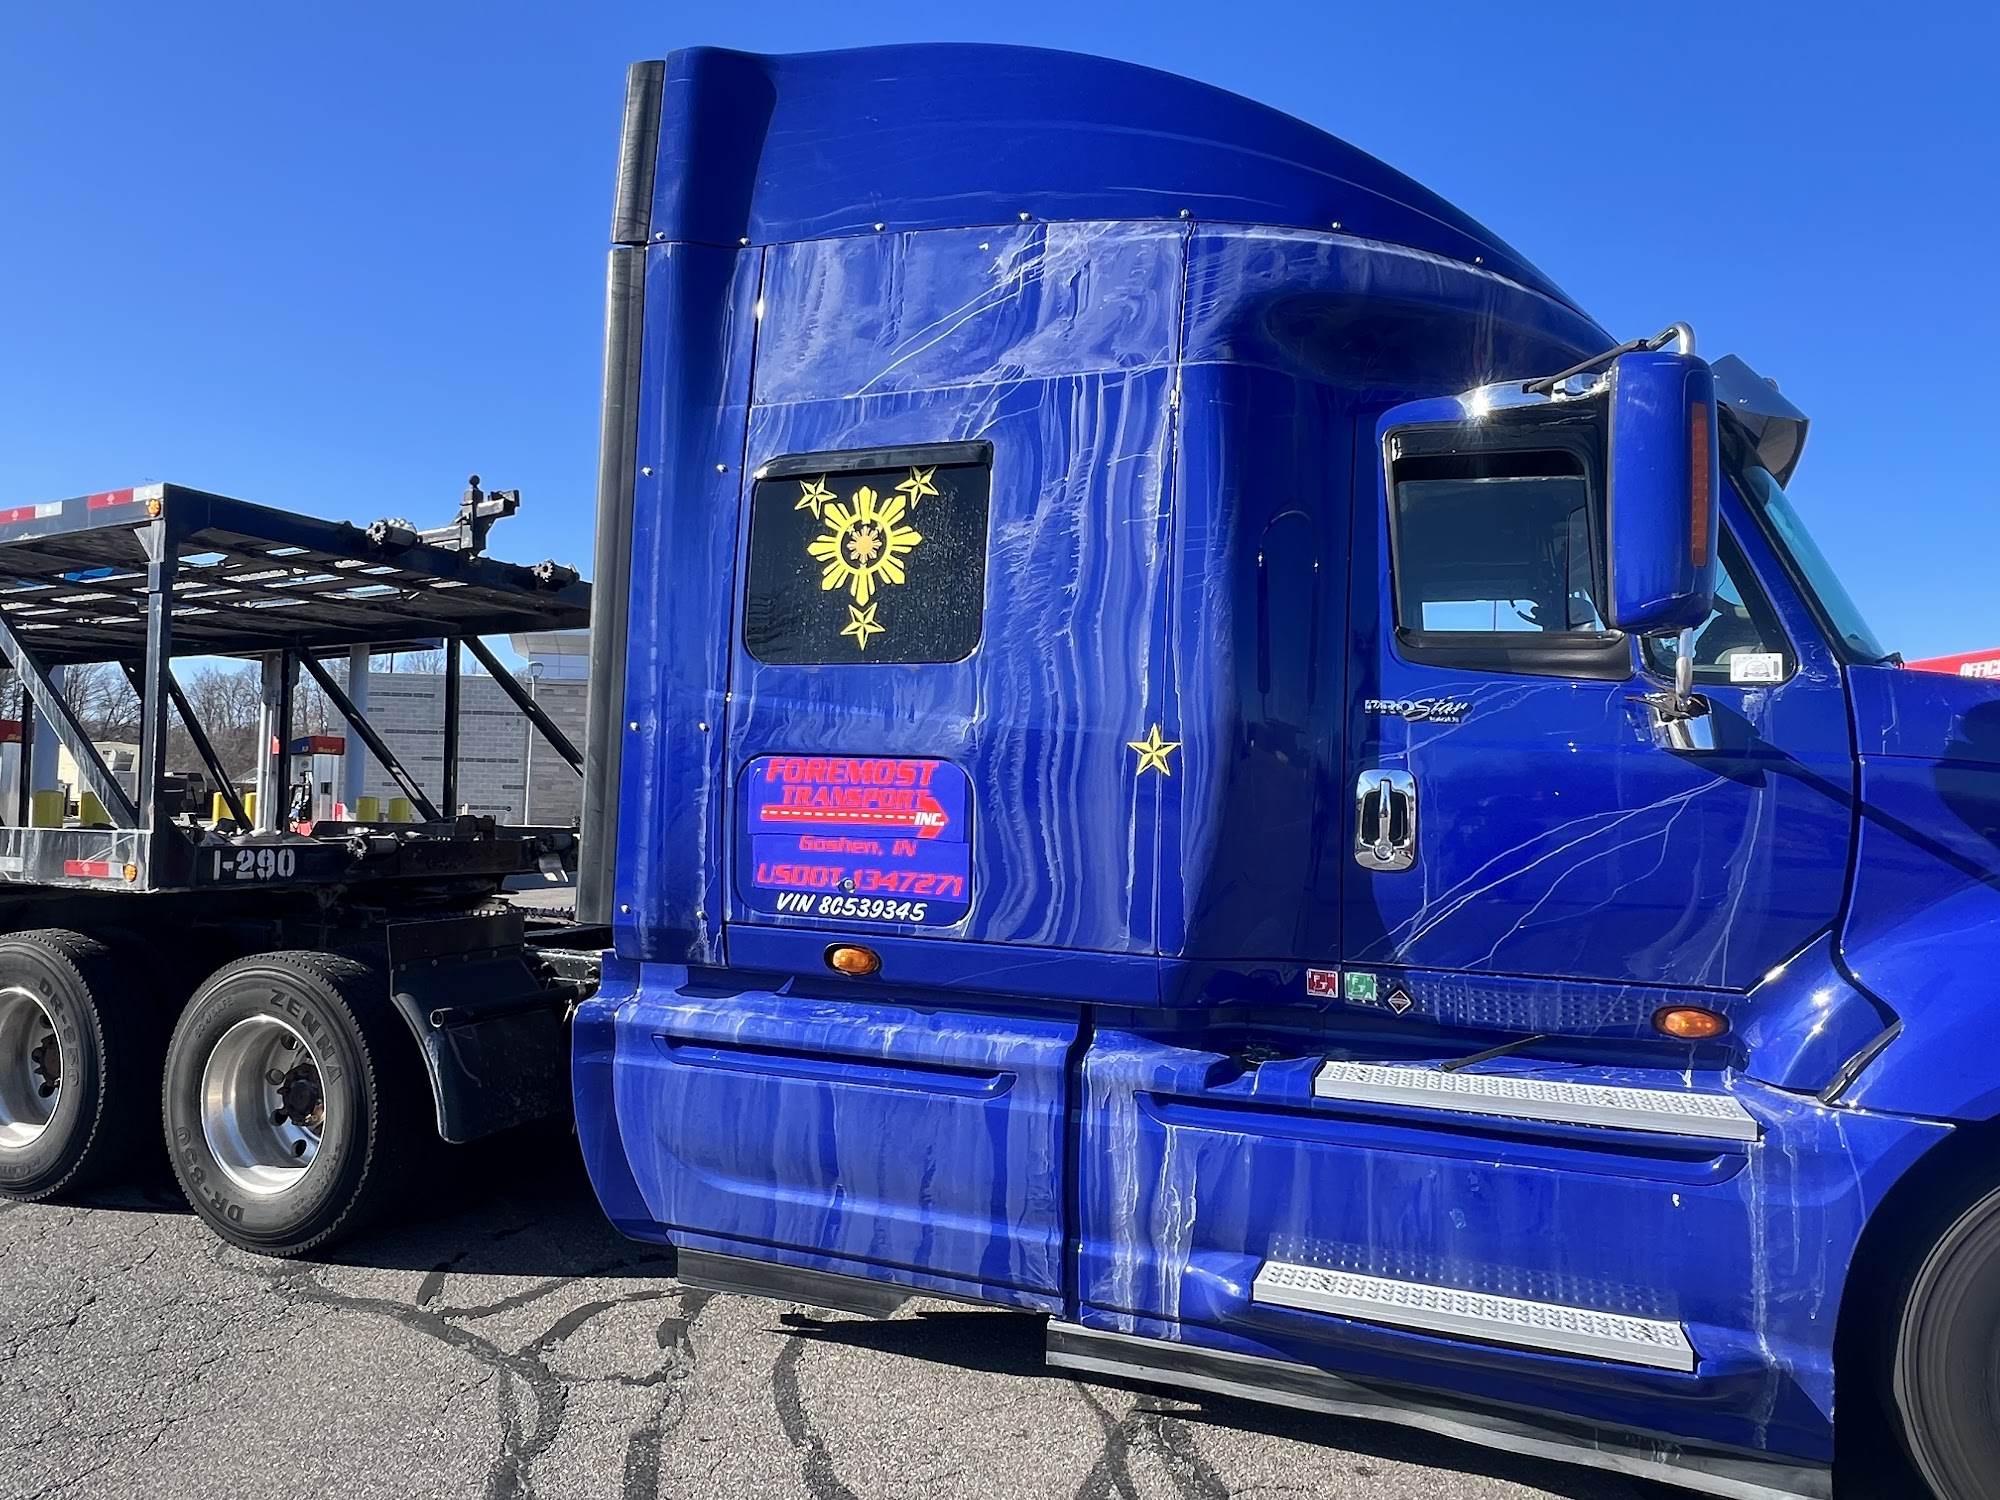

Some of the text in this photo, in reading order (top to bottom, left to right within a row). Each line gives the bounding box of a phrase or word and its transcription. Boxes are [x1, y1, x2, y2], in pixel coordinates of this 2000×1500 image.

[1959, 659, 2000, 678] OFFIC
[766, 758, 939, 786] FOREMOST
[782, 786, 931, 808] TRANSPORT
[914, 811, 945, 827] INC.
[799, 835, 883, 856] Goshen,
[892, 840, 919, 857] IN
[757, 863, 964, 897] USDOT 1347271
[776, 892, 817, 913] VIN
[270, 988, 343, 1086] ZENNA
